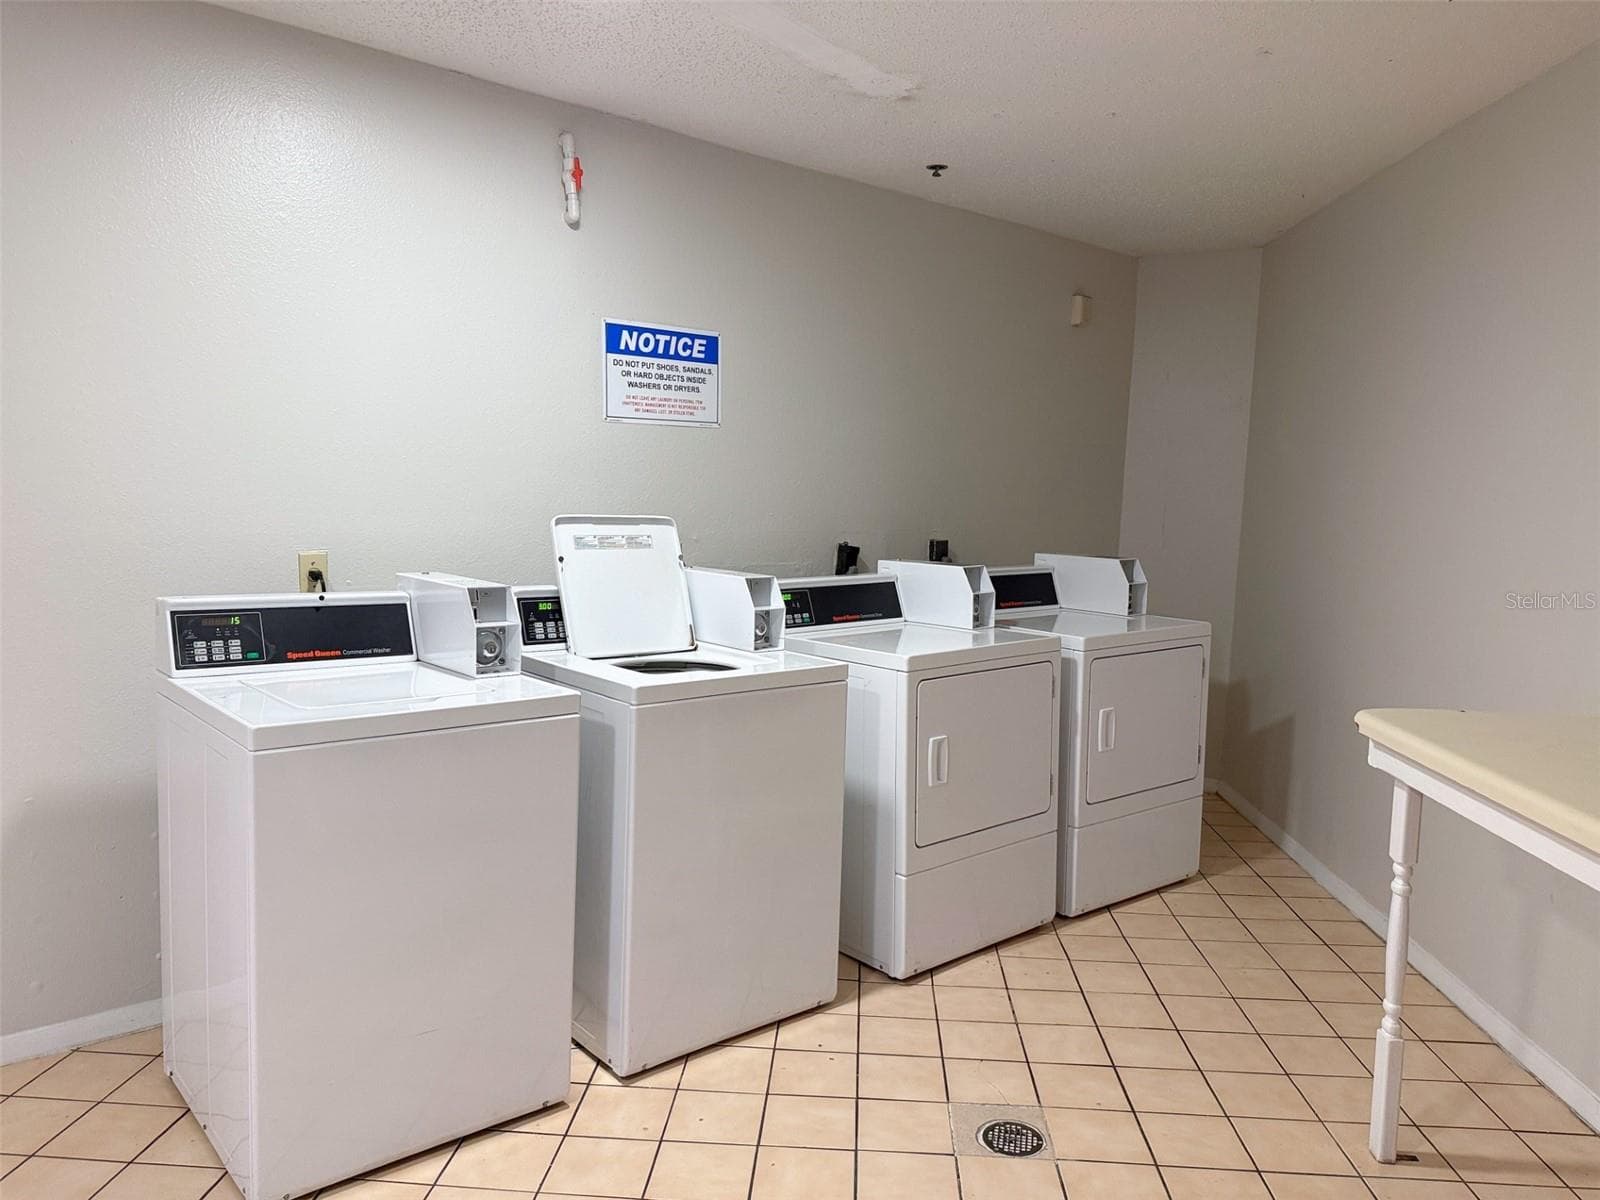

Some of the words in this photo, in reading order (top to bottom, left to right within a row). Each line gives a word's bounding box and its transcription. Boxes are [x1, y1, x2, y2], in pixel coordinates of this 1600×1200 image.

[619, 329, 707, 359] NOTICE
[612, 358, 624, 367] DO
[625, 360, 640, 368] NOT
[641, 361, 655, 370] PUT
[656, 363, 681, 373] SHOES,
[621, 370, 632, 378] OR
[633, 371, 653, 380] HARD
[654, 373, 685, 382] OBJECTS
[686, 376, 707, 384] INSIDE
[627, 381, 661, 390] WASHERS
[674, 385, 702, 394] DRYERS.
[230, 616, 240, 624] 15
[287, 651, 314, 660] Speed
